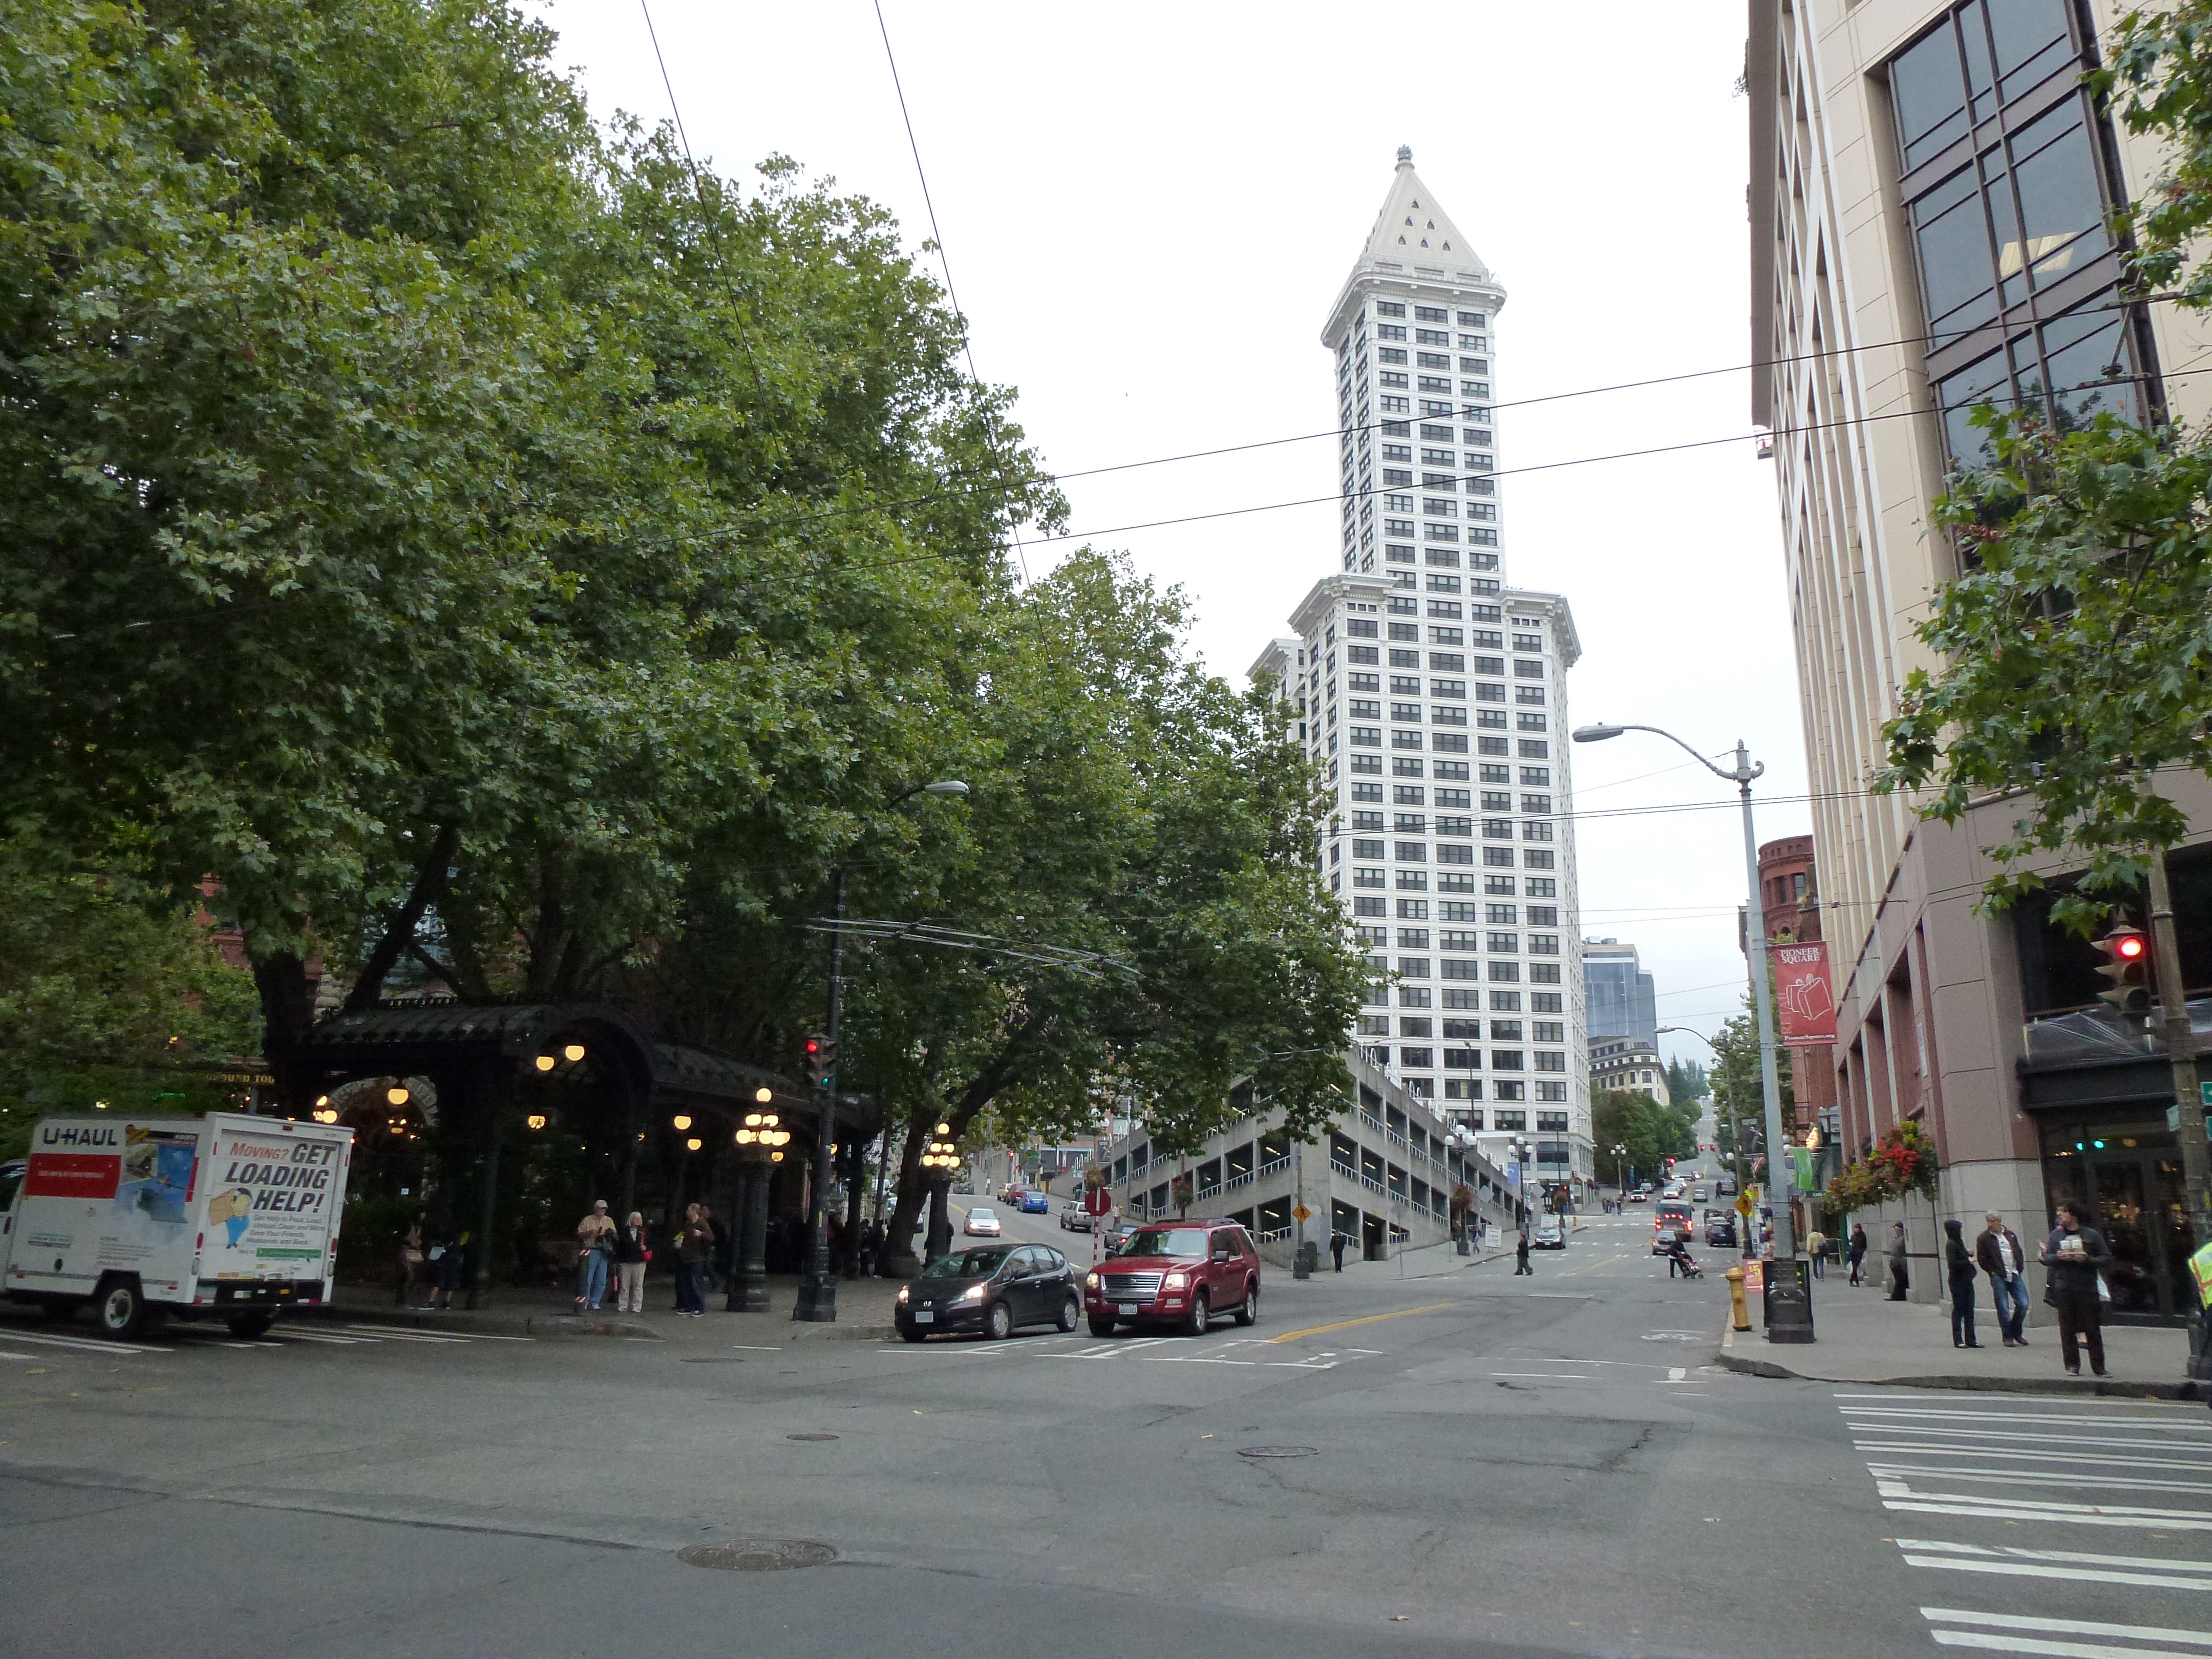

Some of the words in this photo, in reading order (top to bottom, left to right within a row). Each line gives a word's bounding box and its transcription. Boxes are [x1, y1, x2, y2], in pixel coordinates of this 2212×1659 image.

[1780, 948, 1819, 958] PIONEER
[1782, 954, 1820, 964] SQUARE
[1777, 992, 1792, 1034] RETAIL
[43, 1128, 118, 1146] U-HAUL
[230, 1142, 289, 1160] MOVING?
[291, 1143, 338, 1165] GET
[224, 1161, 330, 1189] LOADING
[252, 1189, 325, 1213] HELP!
